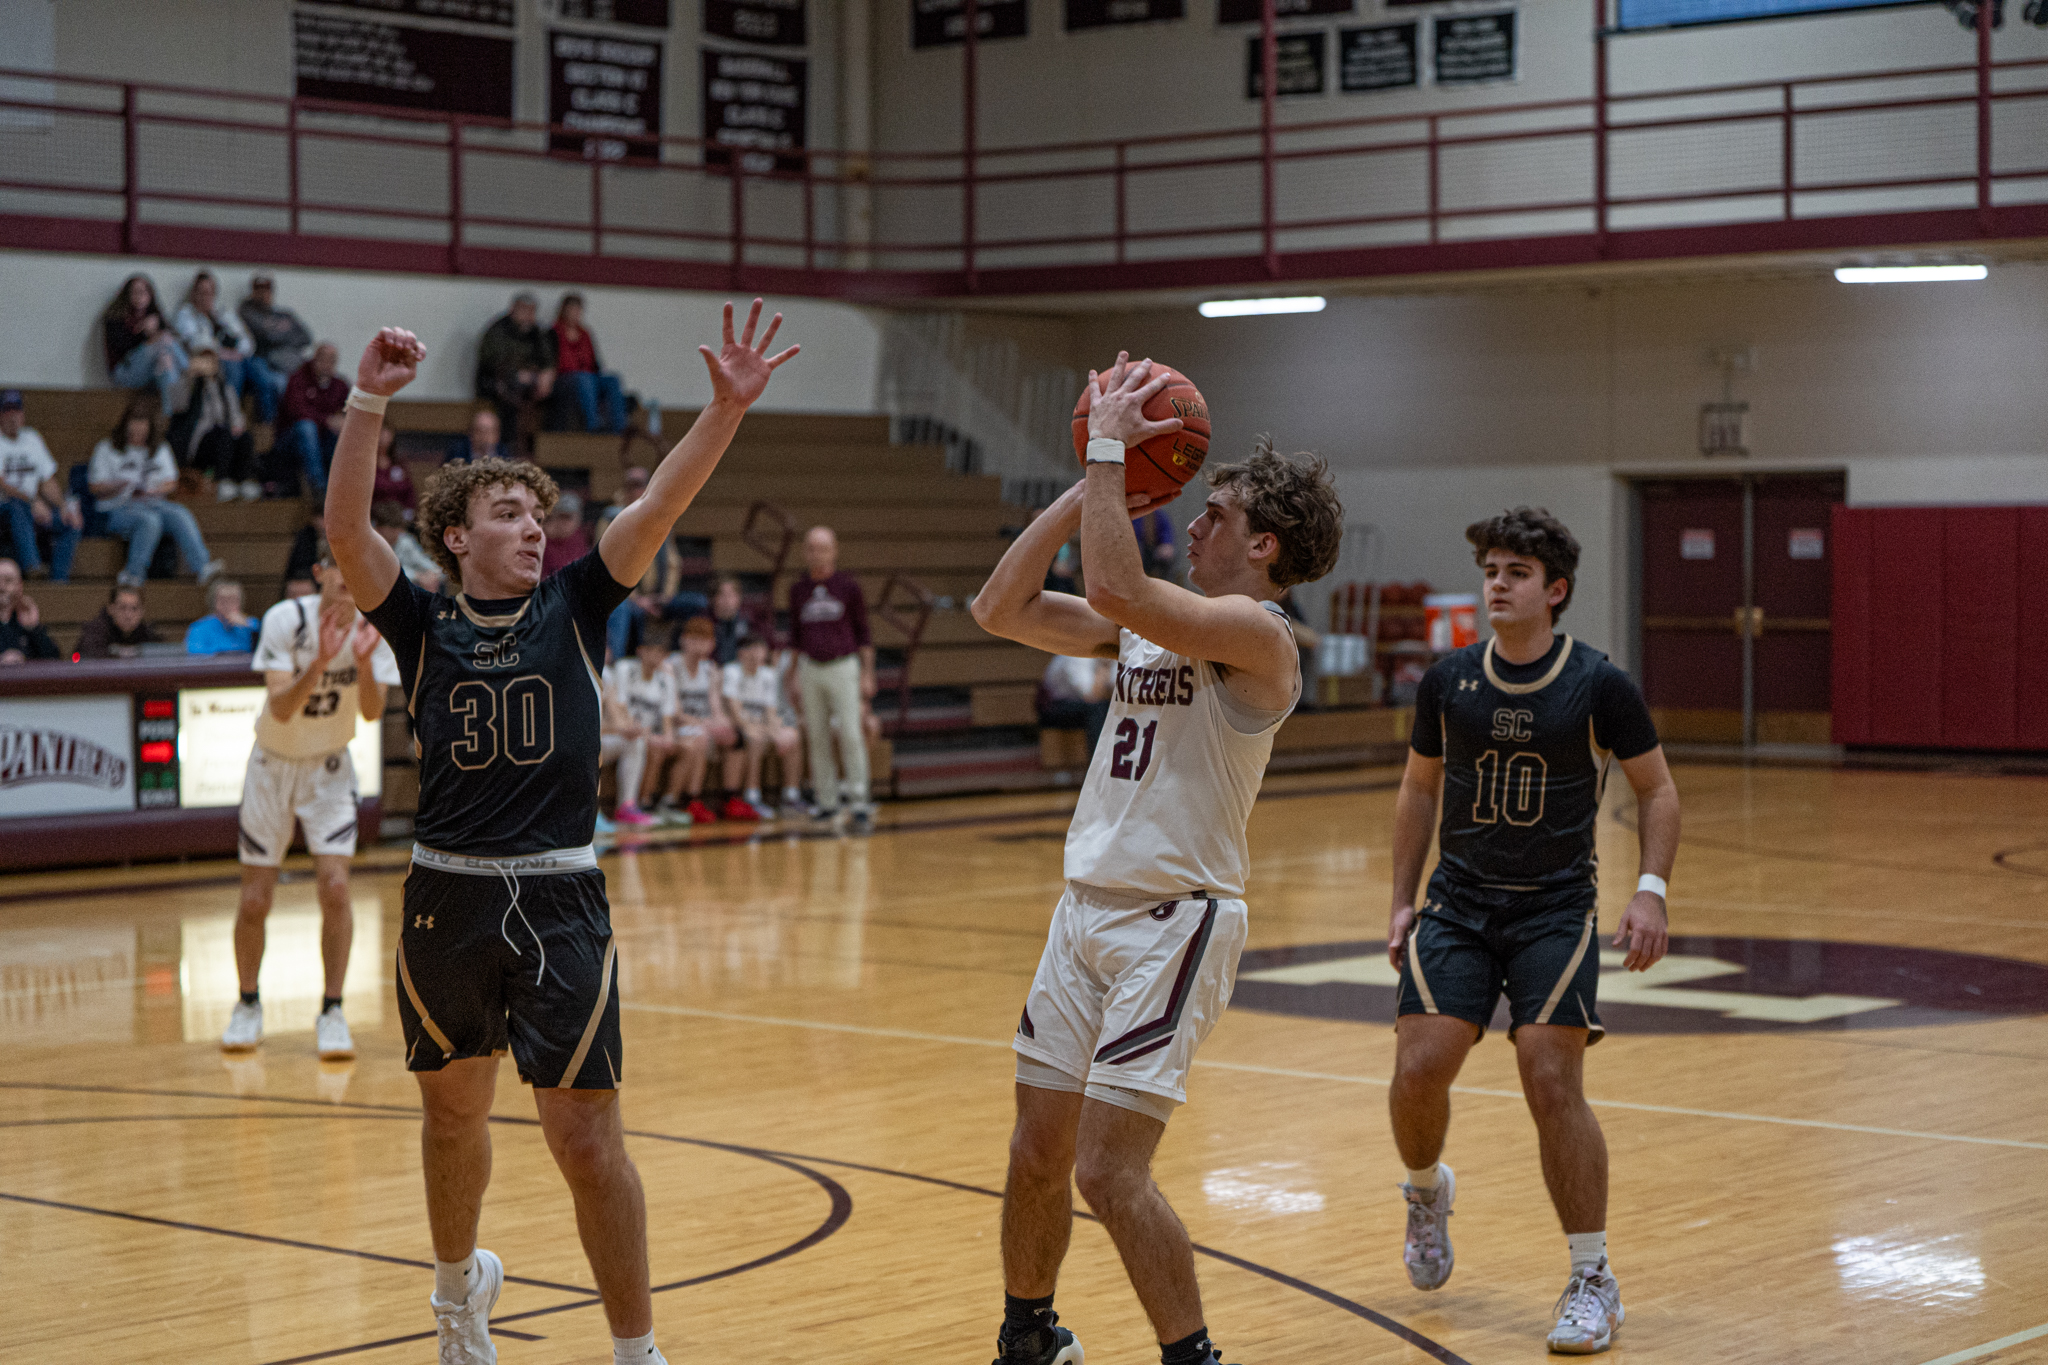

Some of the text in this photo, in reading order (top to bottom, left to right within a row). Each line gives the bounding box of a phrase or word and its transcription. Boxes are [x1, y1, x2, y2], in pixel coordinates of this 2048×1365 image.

[472, 632, 520, 670] SC
[304, 690, 341, 717] 23
[449, 674, 555, 770] 30
[1491, 707, 1534, 742] SC
[1110, 717, 1158, 781] 21
[1472, 749, 1548, 827] 10
